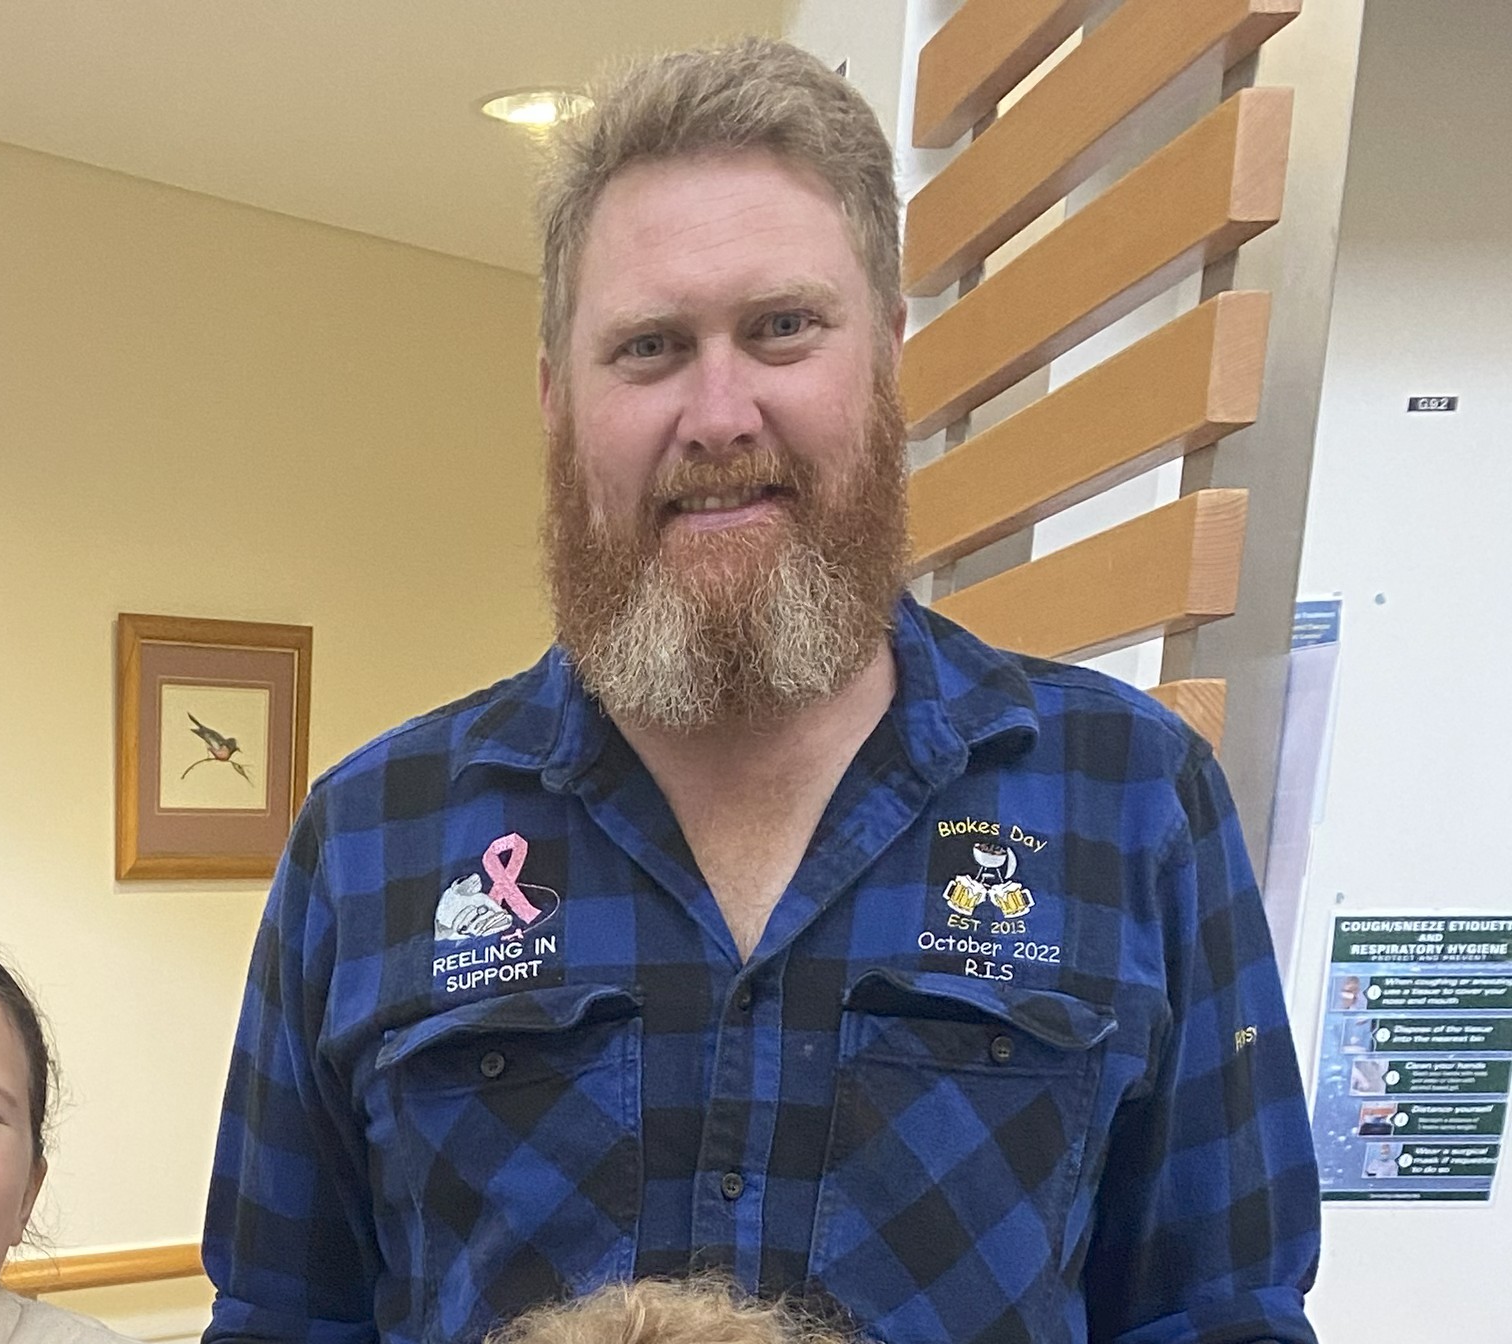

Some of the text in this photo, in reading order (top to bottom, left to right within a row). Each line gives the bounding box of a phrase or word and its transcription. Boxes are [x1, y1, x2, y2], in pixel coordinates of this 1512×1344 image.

[937, 817, 1048, 853] Blokes Day
[947, 914, 1026, 934] EST 2013
[1340, 920, 1445, 932] COUGH/SNEEZE
[918, 932, 1061, 963] October 2022
[1350, 943, 1508, 955] RESPIRATORY HYGIENE
[1418, 933, 1443, 942] AND
[432, 935, 557, 976] REELING IN
[446, 960, 543, 993] SUPPORT
